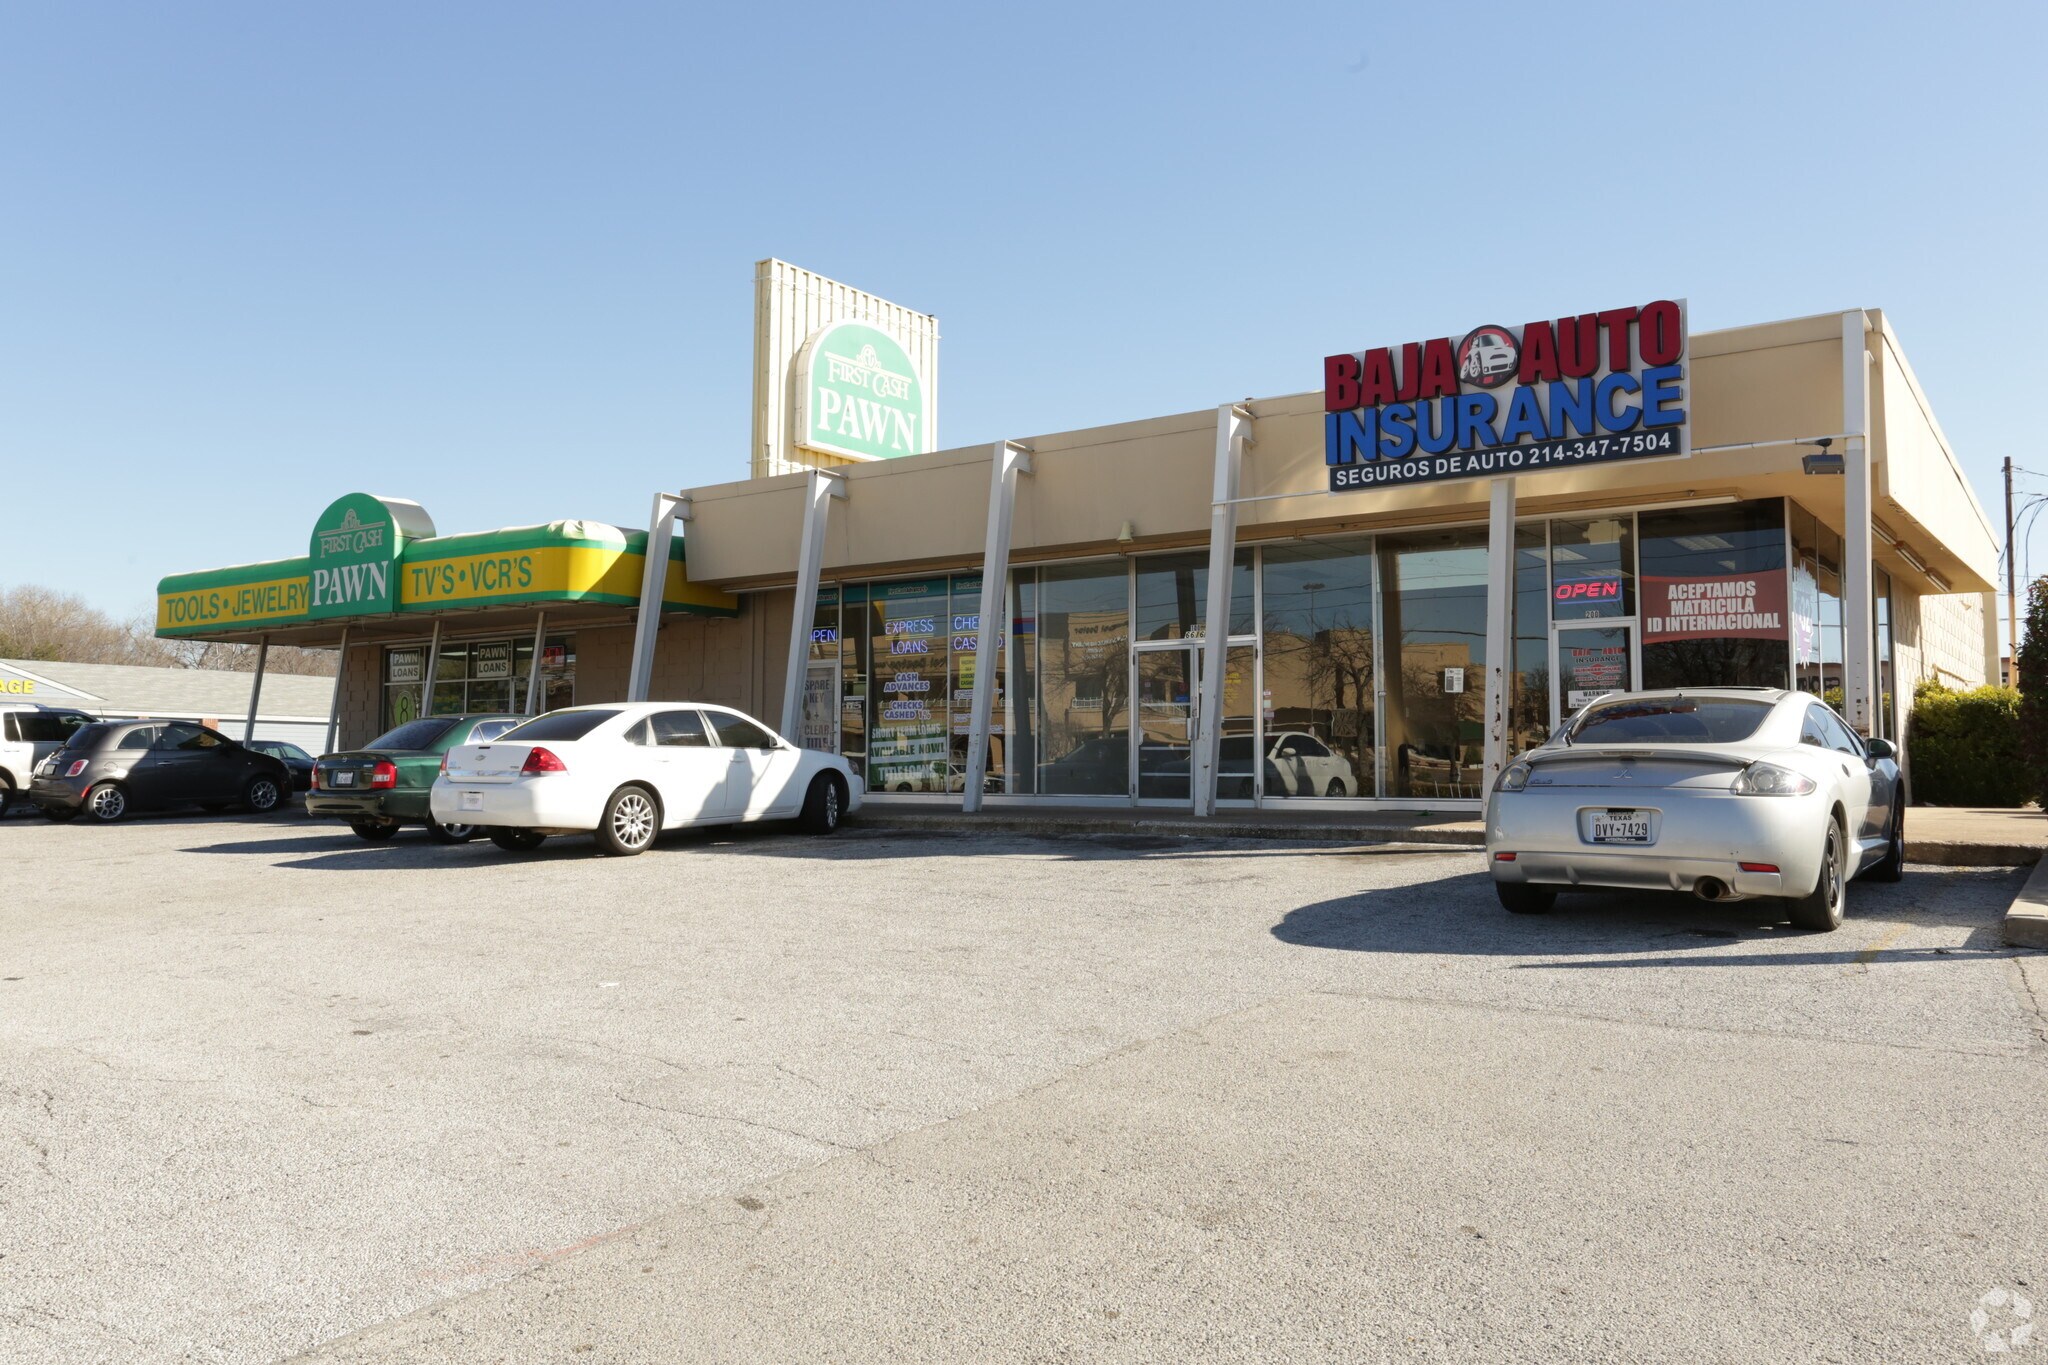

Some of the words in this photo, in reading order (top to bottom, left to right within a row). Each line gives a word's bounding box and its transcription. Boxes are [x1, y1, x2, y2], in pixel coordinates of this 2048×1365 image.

[1325, 338, 1458, 412] BAJA
[1517, 300, 1683, 385] AUTO
[827, 358, 871, 388] FIRST
[873, 373, 909, 400] CASH
[817, 386, 917, 454] PAWN
[1325, 365, 1685, 466] INSURANCE
[1336, 462, 1430, 487] SEGUROS
[1435, 457, 1461, 474] DE
[1466, 450, 1524, 471] AUTO
[1529, 432, 1671, 464] 214-347-7504
[319, 534, 352, 558] FIRST
[353, 530, 383, 553] CASH
[312, 560, 389, 607] PAWN
[412, 564, 454, 597] TV'S
[470, 556, 533, 591] VCR'S
[1555, 582, 1618, 599] OPEN
[1668, 580, 1757, 600] ACEPTAMOS
[166, 592, 220, 623] TOOLS
[232, 582, 309, 617] JEWELRY
[1671, 597, 1754, 615] MATRICULA
[1585, 610, 1600, 619] 200
[1647, 617, 1663, 632] ID
[1666, 613, 1781, 632] INTERNACIONAL
[885, 619, 934, 635] EXPRESS
[810, 628, 837, 644] PEN
[479, 647, 507, 659] PAWN
[891, 640, 928, 655] LOANS
[393, 652, 418, 664] PAWN
[392, 668, 418, 678] LOANS
[478, 662, 507, 673] LOANS
[805, 680, 829, 690] SPARE
[896, 673, 918, 682] CASH
[884, 682, 930, 692] ADVANCES
[891, 701, 923, 710] CHECKS
[884, 711, 915, 719] CASHED
